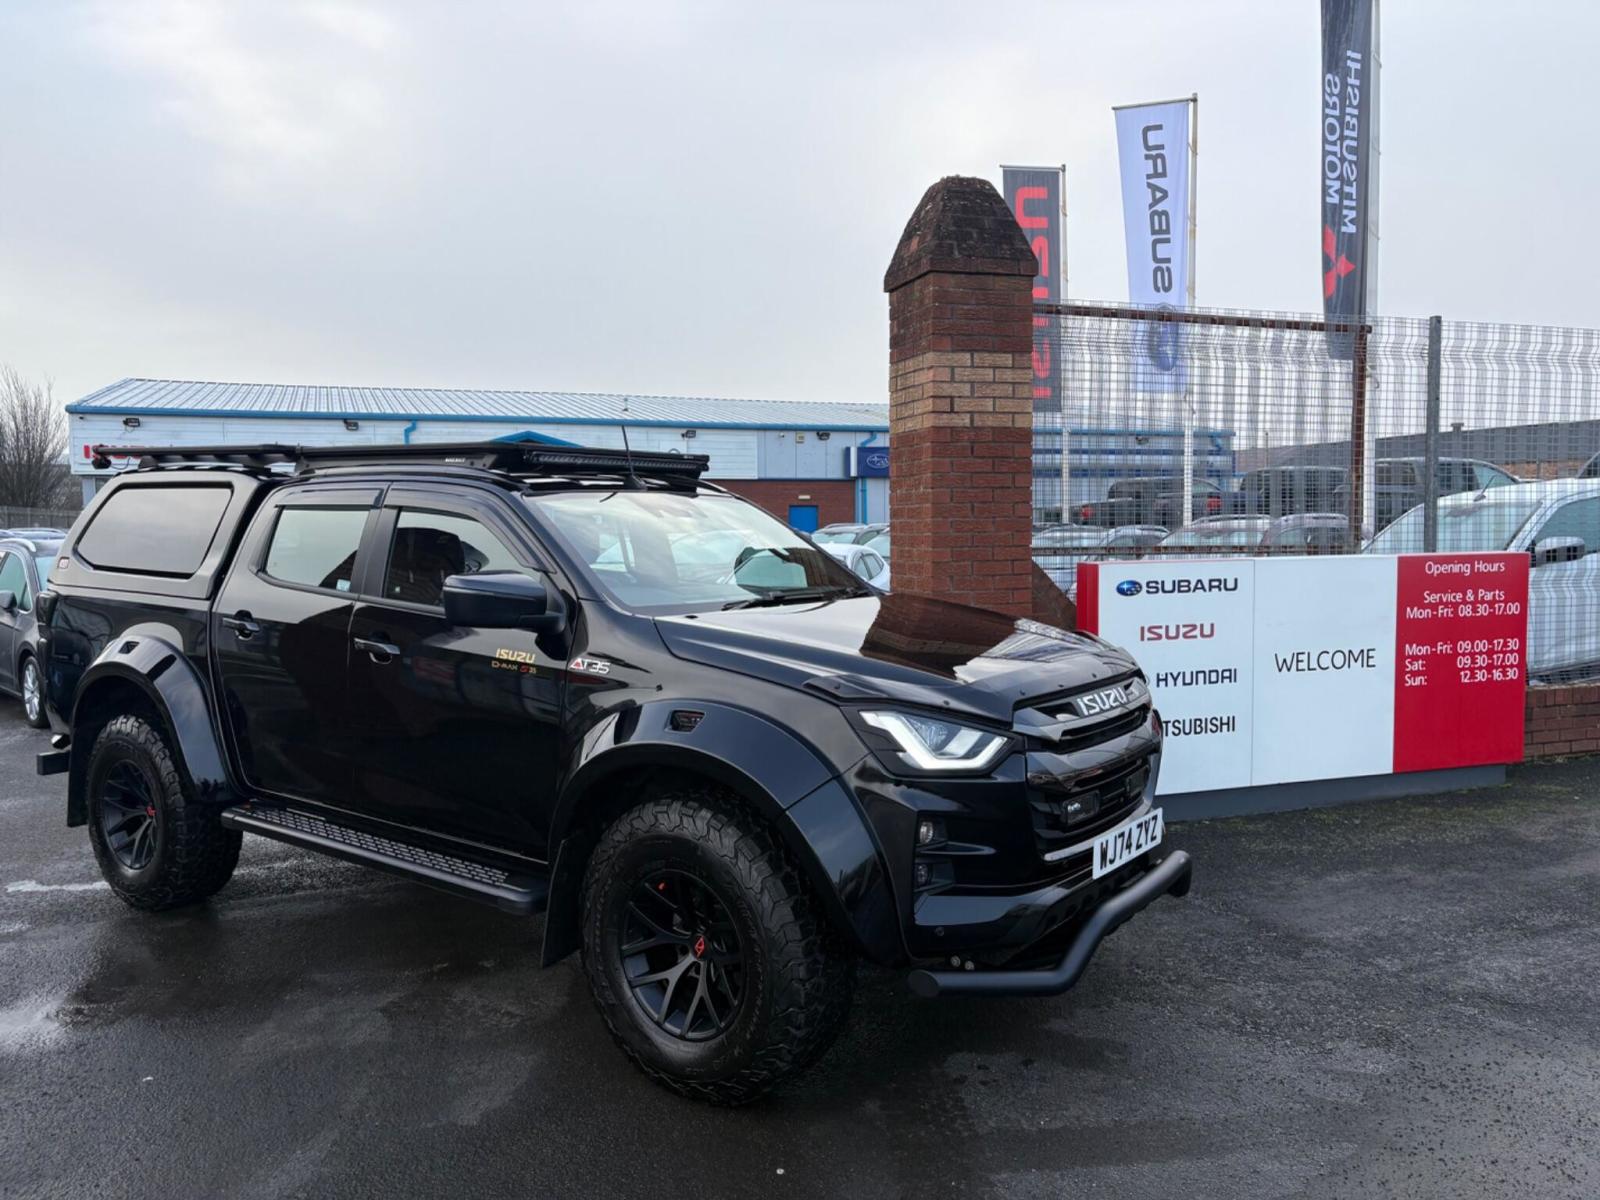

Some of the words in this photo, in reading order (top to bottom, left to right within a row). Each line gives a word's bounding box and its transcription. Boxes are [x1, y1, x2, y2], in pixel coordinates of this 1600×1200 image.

[1425, 560, 1471, 576] Opening
[1474, 560, 1506, 573] Hours
[1145, 577, 1239, 595] SUBARU
[1423, 589, 1463, 604] Service
[1466, 588, 1475, 602] &
[1478, 588, 1506, 602] Parts
[1458, 602, 1520, 617] 08.30-17.00
[1139, 623, 1215, 642] ISUZU
[1456, 638, 1519, 654] 09.00-17.30
[495, 647, 536, 664] ISUZU
[1274, 647, 1377, 673] WELCOME
[1405, 658, 1427, 671] Sat:
[1456, 653, 1519, 668] 09.30-17.00
[568, 657, 611, 674] AT35
[1156, 668, 1238, 688] HYUNDAI
[1404, 673, 1428, 687] Sun:
[1459, 667, 1519, 683] 12.30-16.30
[1077, 686, 1127, 716] ISUZU
[1162, 715, 1236, 738] TSUBISHI
[1099, 831, 1132, 870] WJ74
[1135, 814, 1158, 850] ZYZ
